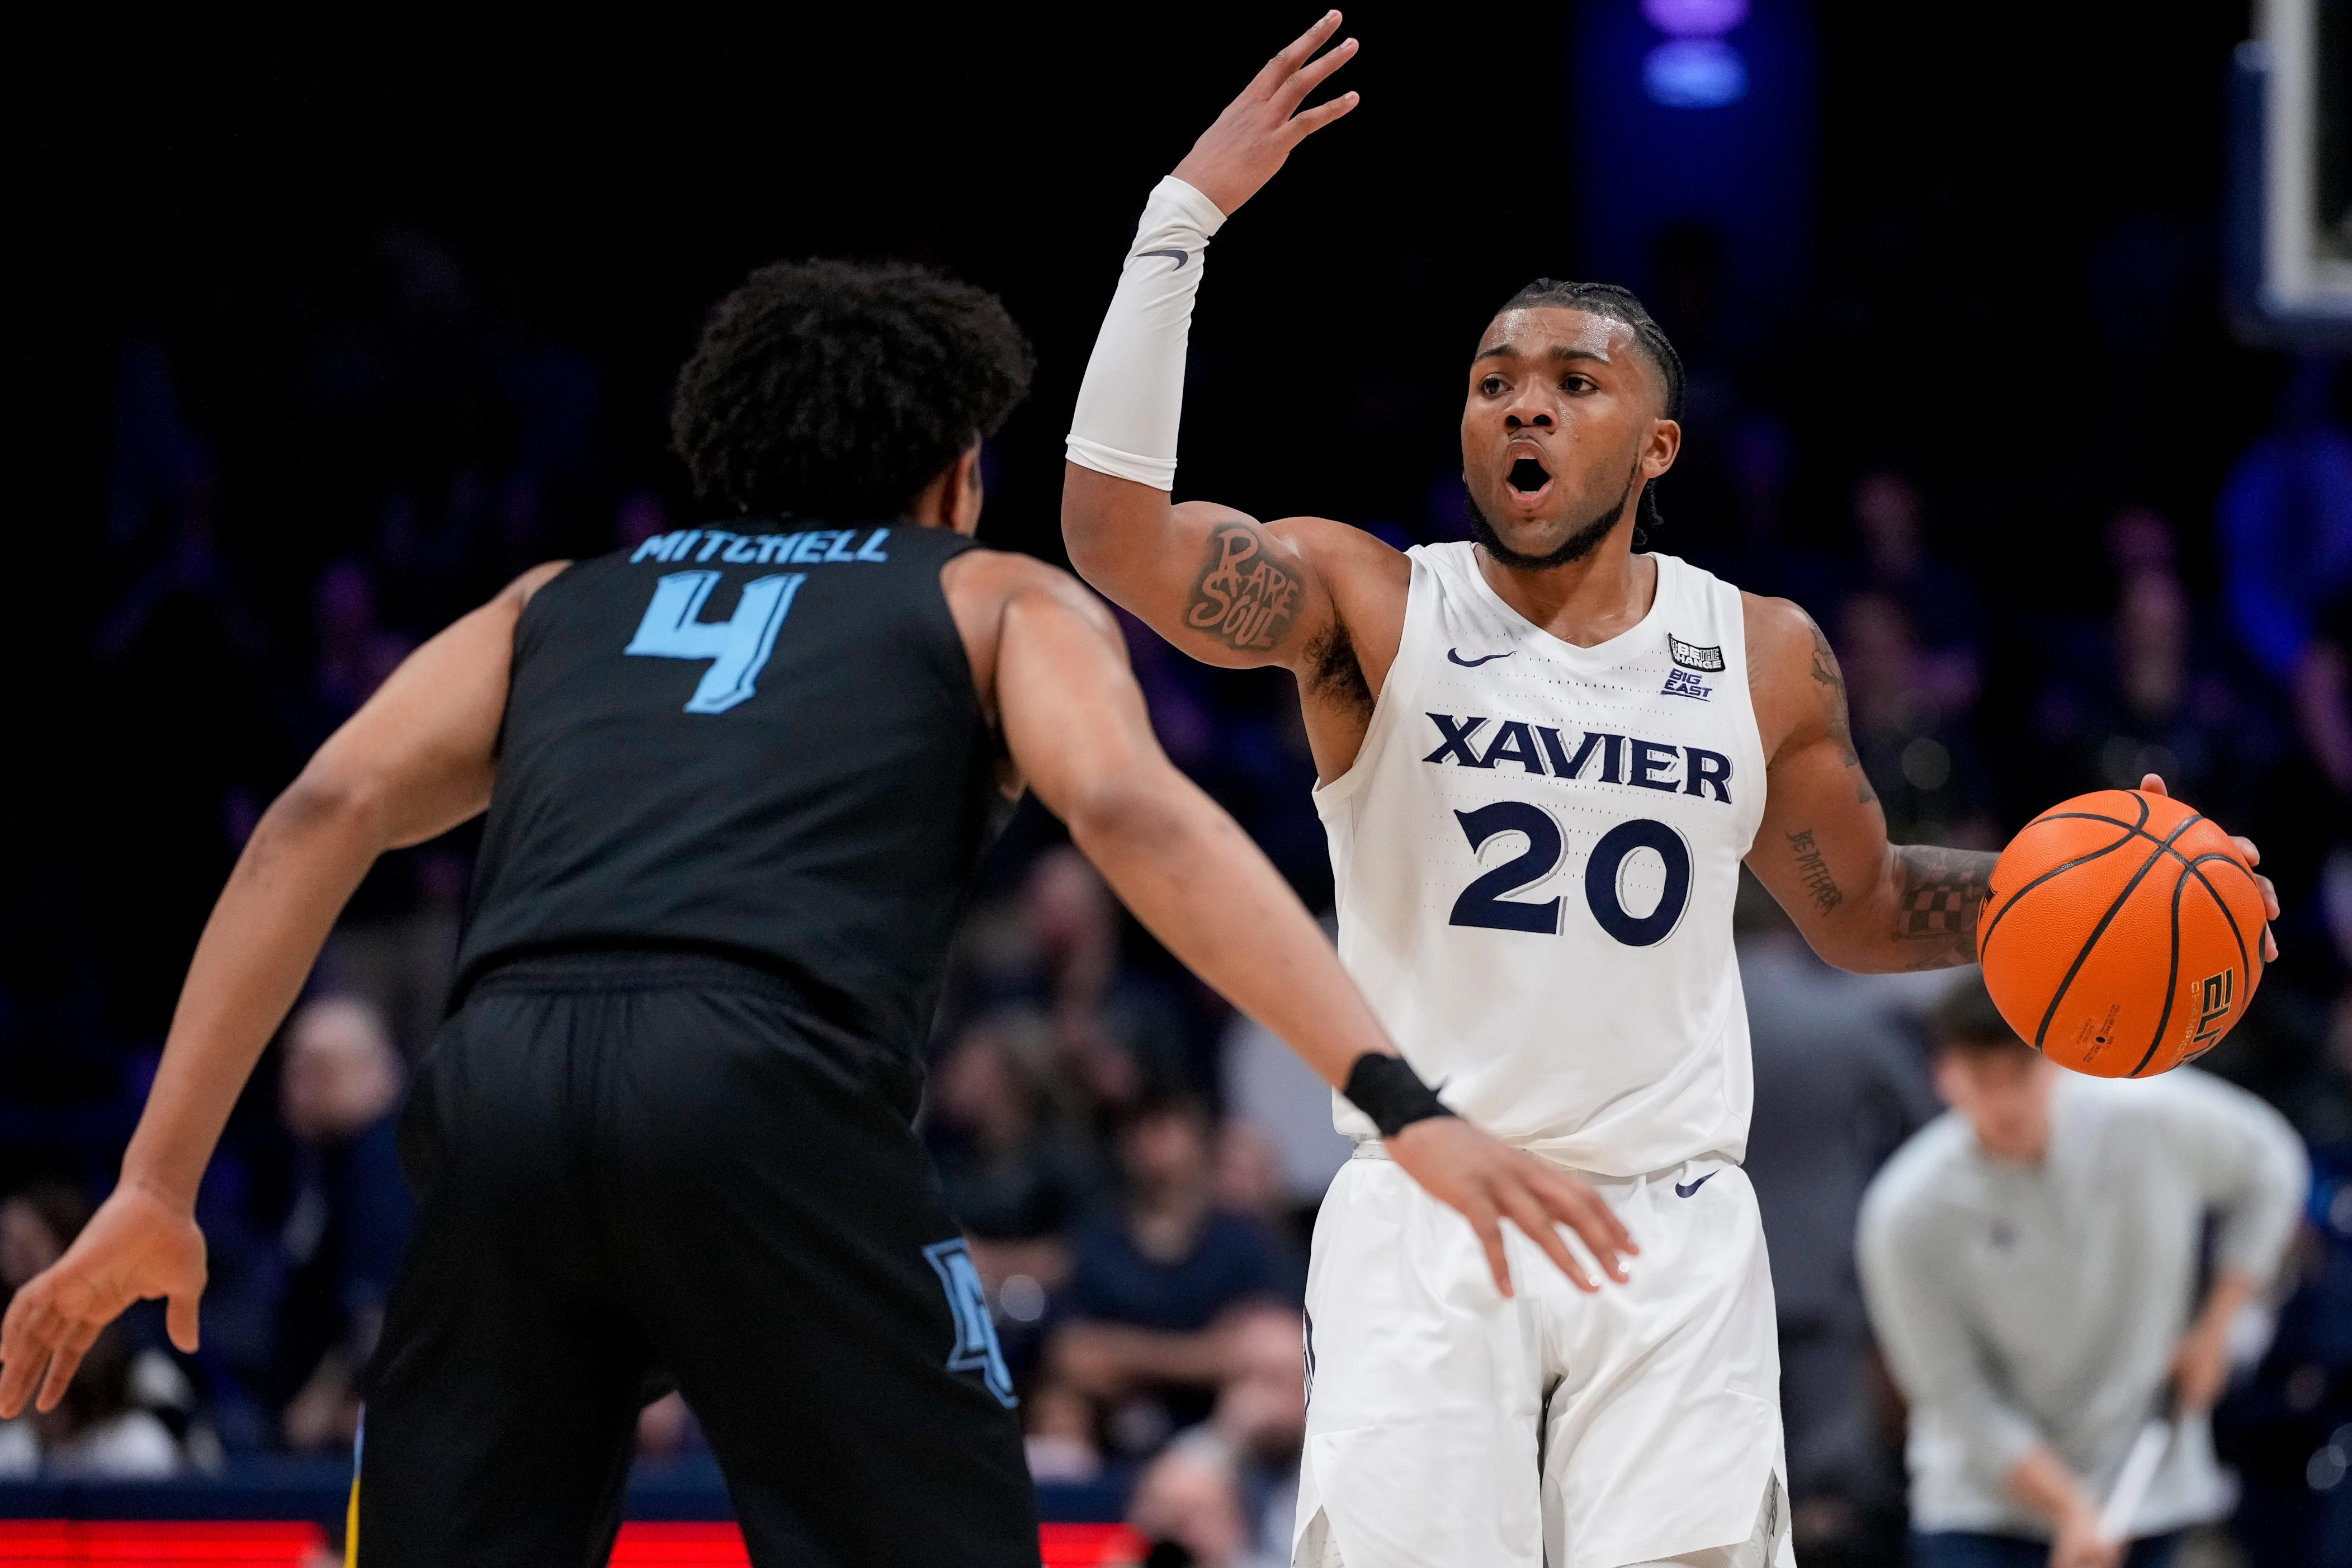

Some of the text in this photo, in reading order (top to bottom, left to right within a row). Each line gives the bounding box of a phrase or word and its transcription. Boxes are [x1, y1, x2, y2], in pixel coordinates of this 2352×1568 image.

[630, 527, 891, 564] MITCHELL
[623, 569, 807, 715] 4
[1678, 642, 1701, 660] BE
[1699, 648, 1720, 661] THE
[1664, 679, 1713, 697] EAST
[1669, 668, 1702, 685] BIG
[1421, 712, 1734, 804] XAVIER
[1448, 801, 1694, 948] 20
